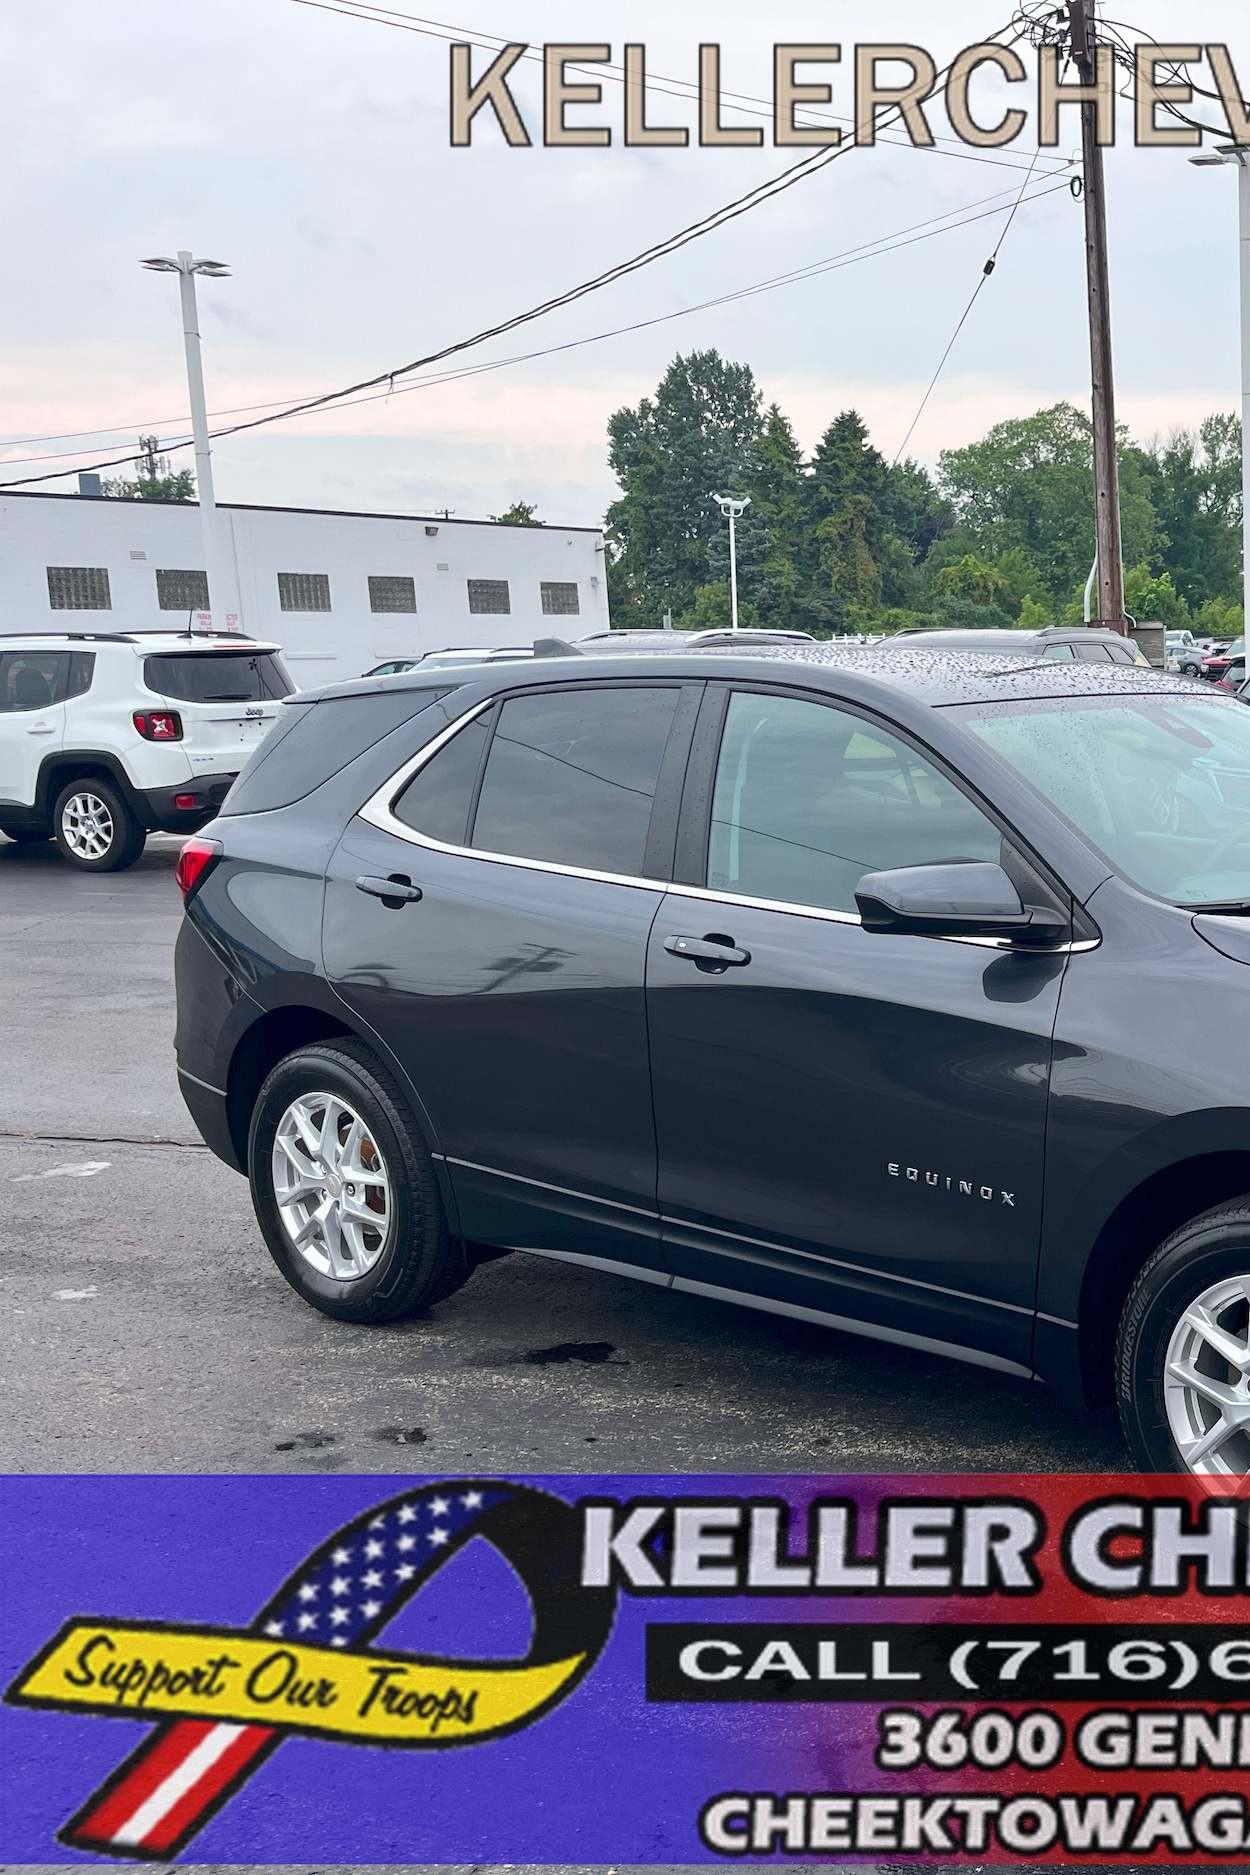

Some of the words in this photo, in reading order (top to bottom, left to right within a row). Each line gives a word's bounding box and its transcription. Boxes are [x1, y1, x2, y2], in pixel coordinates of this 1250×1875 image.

[245, 708, 264, 717] Jeep
[887, 1162, 1015, 1207] EQUINOX
[1121, 1285, 1152, 1403] BRIDGESTONE
